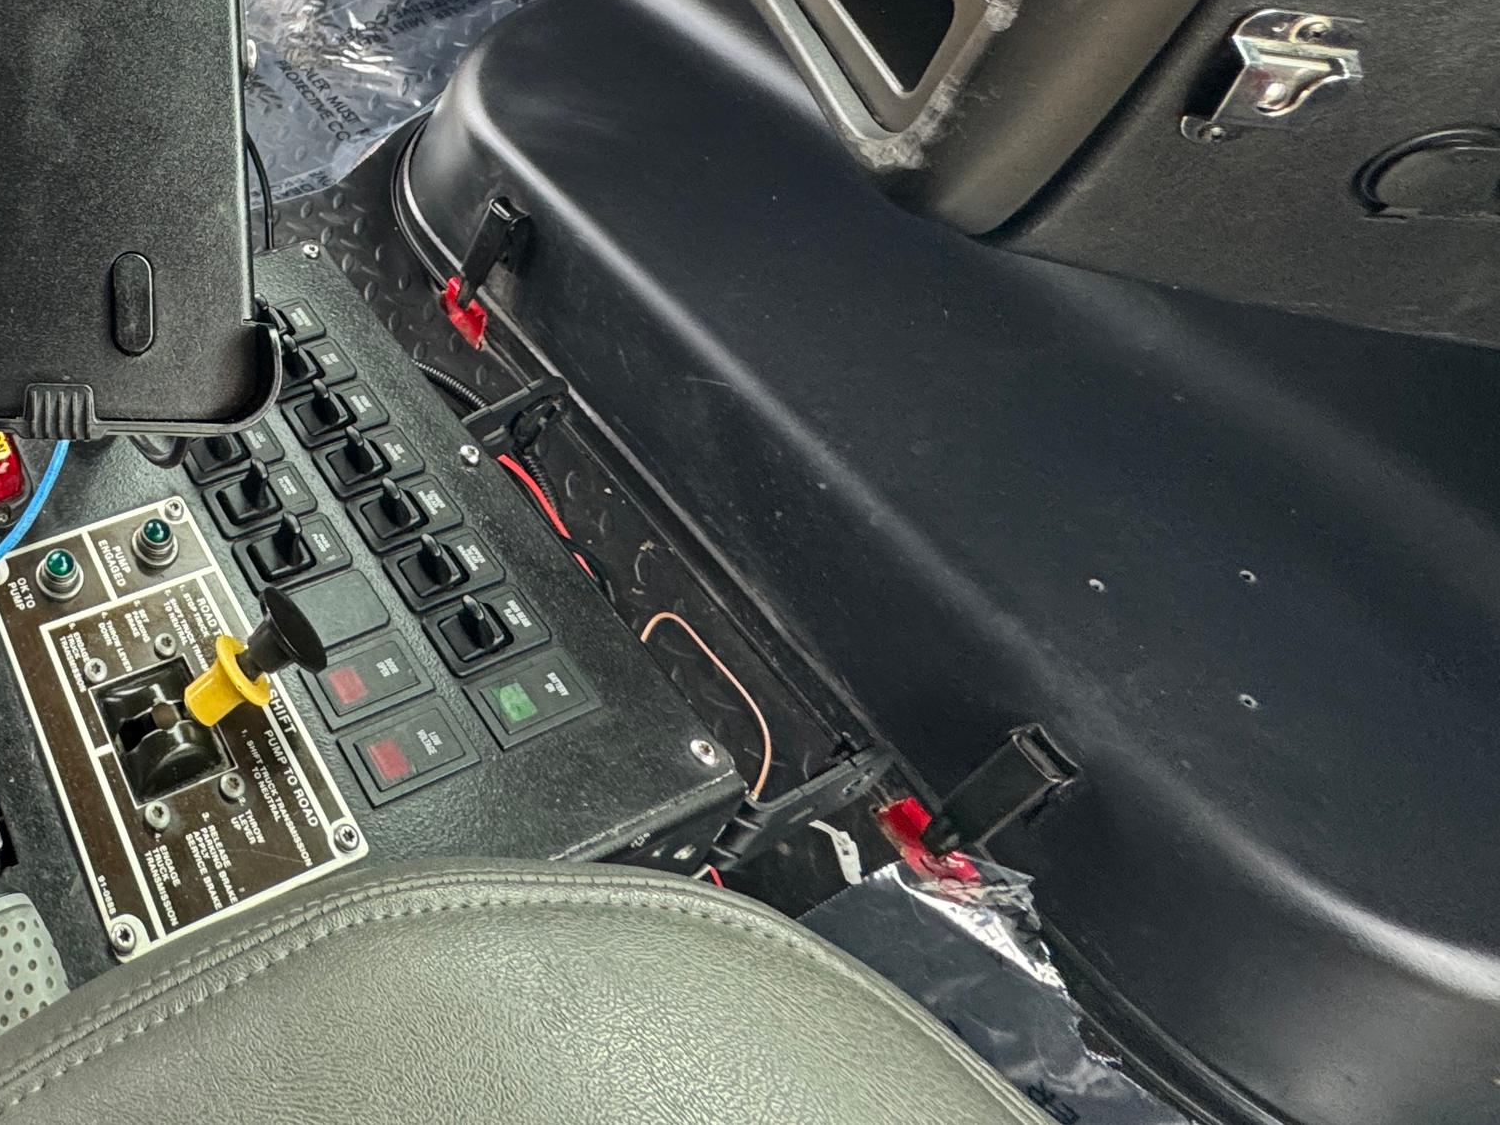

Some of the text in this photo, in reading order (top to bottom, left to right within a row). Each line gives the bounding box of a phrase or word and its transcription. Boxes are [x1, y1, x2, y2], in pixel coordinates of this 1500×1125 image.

[275, 59, 333, 124] PROTECTIVE
[328, 95, 361, 124] MUST
[98, 539, 127, 588] ENGAGED
[112, 545, 132, 574] PUMP
[7, 582, 26, 611] PUMP
[16, 577, 36, 609] OK TO
[124, 612, 141, 638] BRAKE
[132, 610, 151, 643] PARKING
[139, 608, 150, 623] SET
[168, 612, 188, 646] NEUTRAL
[169, 598, 184, 618] SHIFT
[180, 618, 196, 645] TRUCK
[183, 593, 197, 612] STOP
[193, 612, 210, 638] TRUCK
[196, 597, 217, 628] ROAD
[66, 633, 80, 660] TRUCK
[73, 631, 90, 663] ENGAGE
[98, 622, 113, 647] DOWN
[106, 620, 122, 648] THROW
[117, 646, 133, 673] LEVER
[59, 635, 87, 693] TRANSMISSION
[376, 662, 390, 677] OPEN
[384, 657, 399, 674] DOOR
[547, 672, 569, 697] BATTERY
[269, 687, 298, 735] SHIFT
[416, 729, 438, 756] VOLTAGE
[428, 731, 443, 746] LOW
[264, 729, 319, 827] PUMP TO ROAD
[246, 739, 263, 767] SHIFT
[260, 764, 279, 796] TRUCK
[276, 795, 313, 867] TRANSMISSION
[258, 780, 281, 823] NEUTRAL
[230, 817, 242, 831] UP
[238, 813, 257, 845] LEVER
[245, 809, 266, 844] THROW
[192, 830, 211, 860] APPLY
[207, 825, 232, 868] RELEASE
[152, 847, 170, 882] TRUCK
[159, 844, 181, 887] ENGAGE
[185, 833, 223, 910] SERVICE BRAKE
[200, 827, 239, 905] PARKING BRAKE
[144, 850, 179, 926] TRANSMISSION
